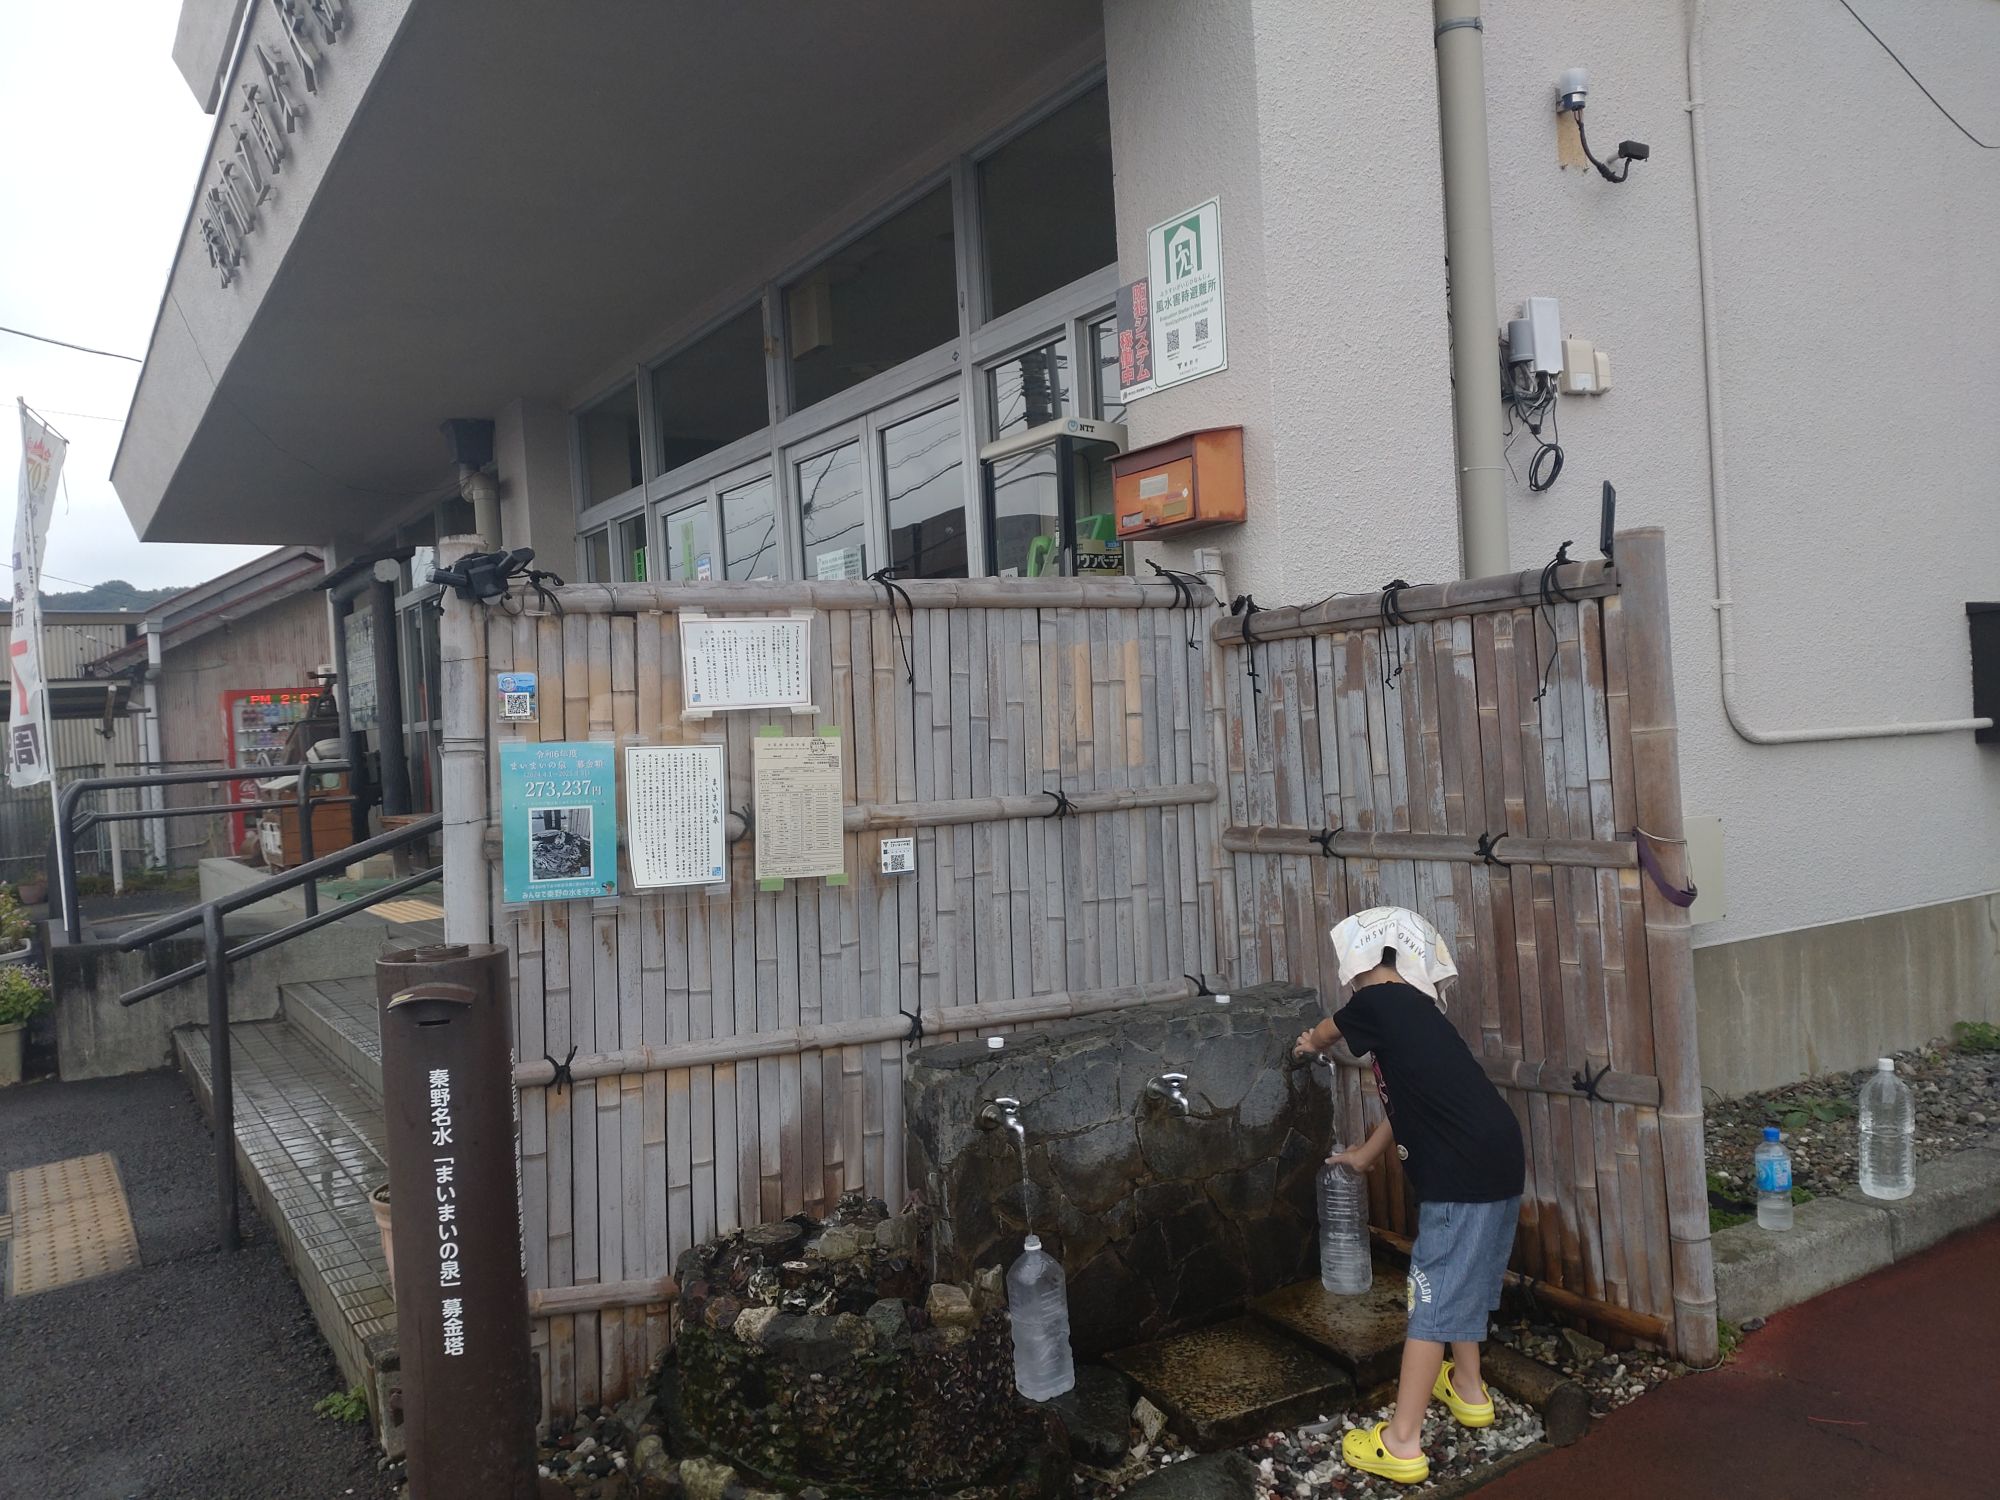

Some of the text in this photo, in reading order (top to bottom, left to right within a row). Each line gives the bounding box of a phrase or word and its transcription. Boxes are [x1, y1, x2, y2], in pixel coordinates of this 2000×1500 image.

[1156, 278, 1217, 314] 風水害時避難所
[1133, 283, 1150, 381] 防犯システム
[1120, 329, 1135, 386] 稼働中
[1079, 423, 1095, 433] NTT
[249, 694, 271, 705] PM
[525, 780, 603, 798] 273,237円
[522, 890, 601, 900] みんなで秦野の水を守ろう
